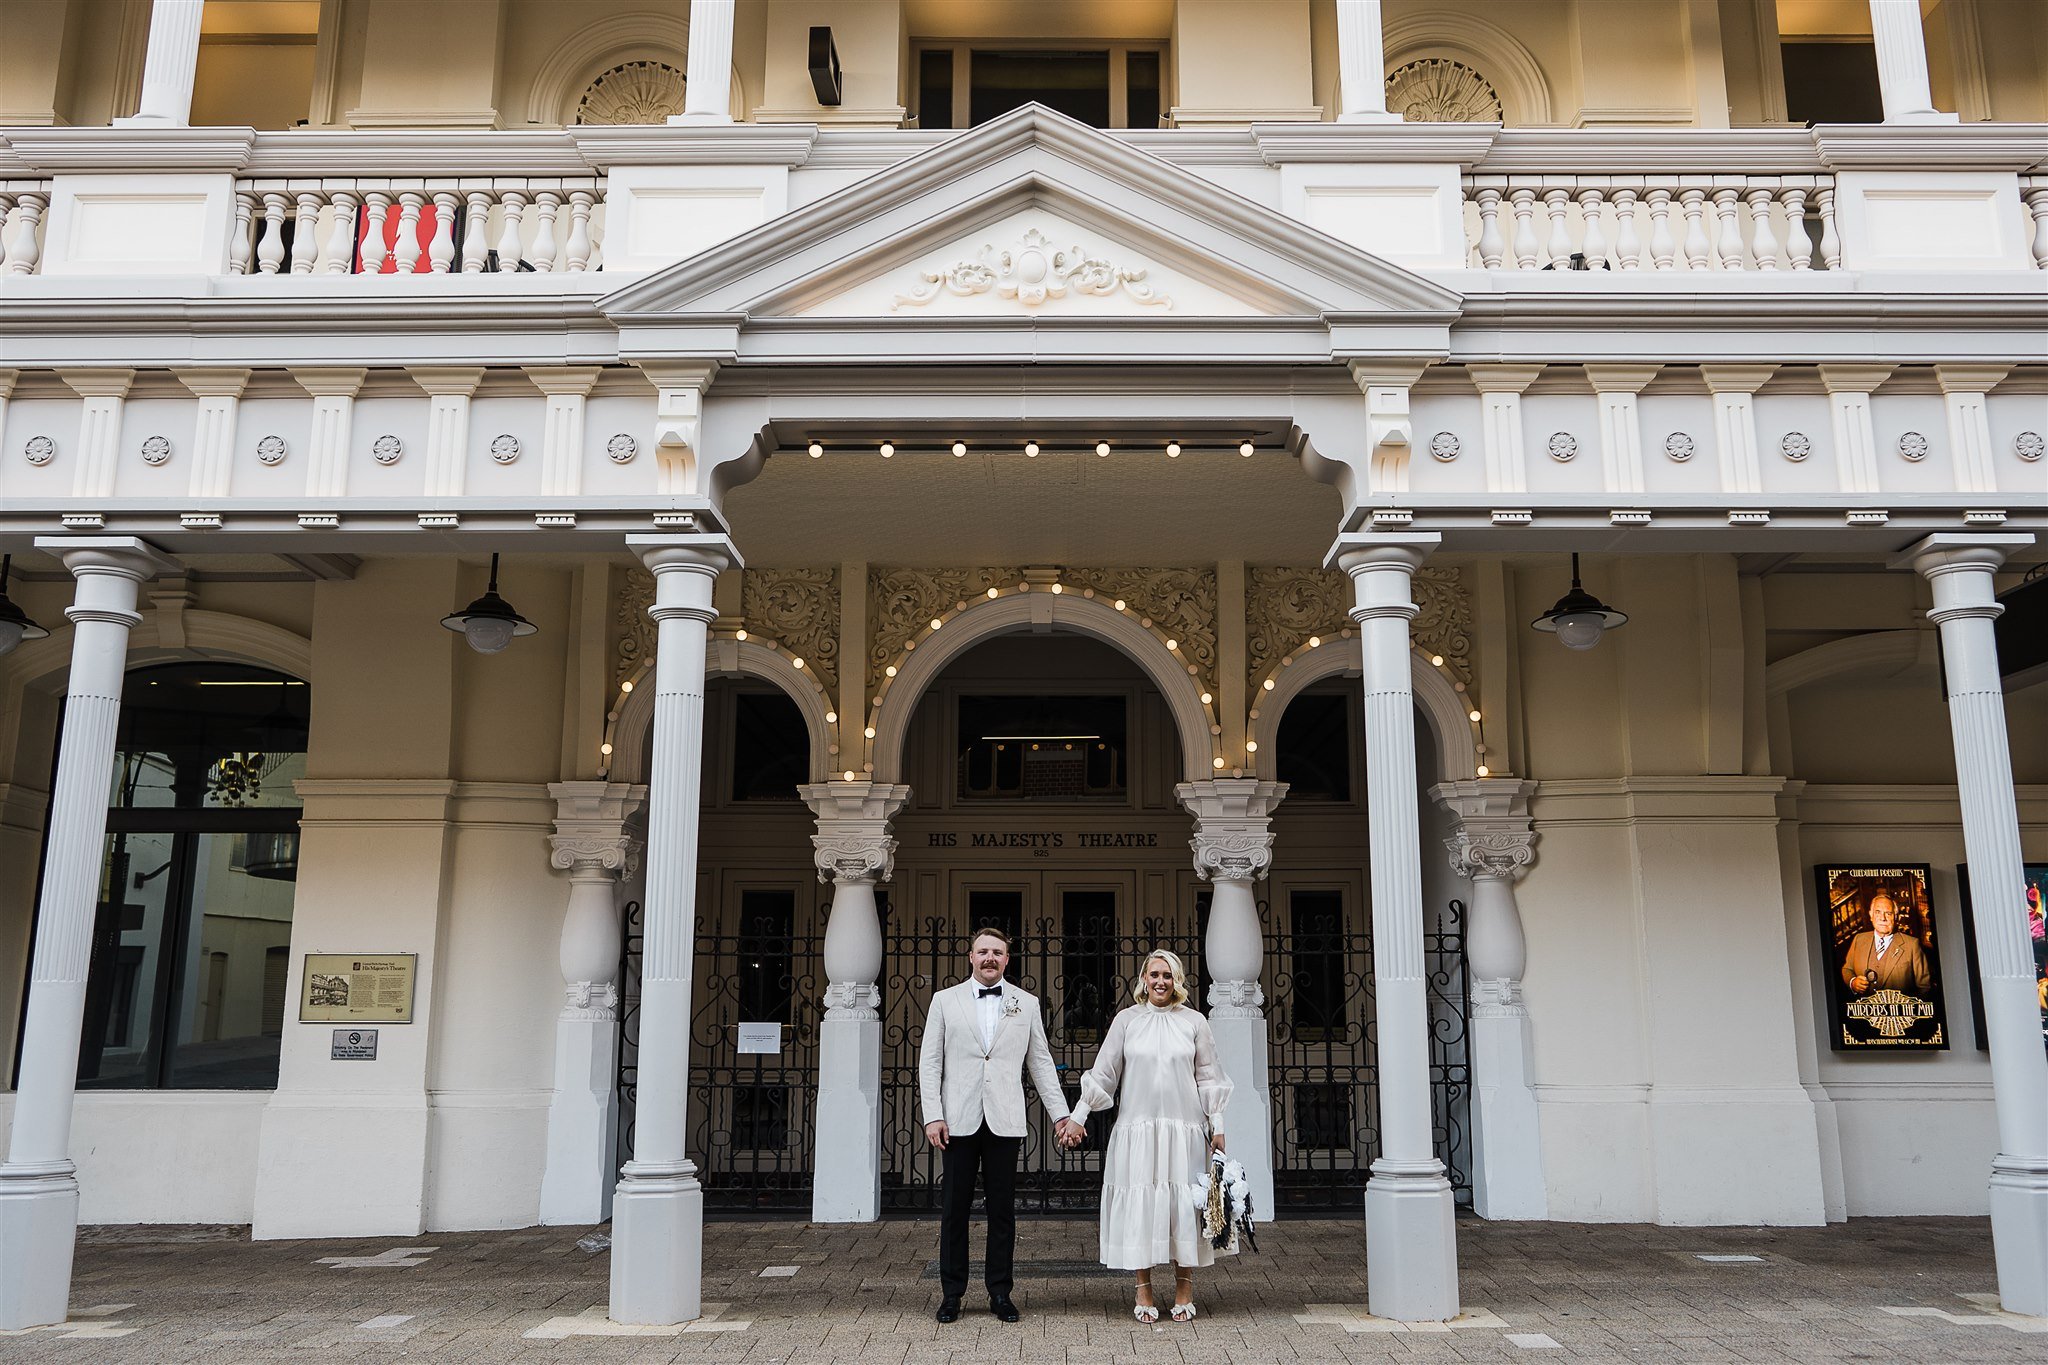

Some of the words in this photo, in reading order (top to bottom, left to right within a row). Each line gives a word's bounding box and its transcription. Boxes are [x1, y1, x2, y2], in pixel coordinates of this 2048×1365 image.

[928, 833, 957, 847] HIS
[971, 832, 1063, 847] MAJESTY'S
[1078, 833, 1157, 847] THEATRE
[1846, 1004, 1888, 1016] MURDERS
[1889, 1004, 1899, 1016] AT
[1901, 1004, 1915, 1016] THE
